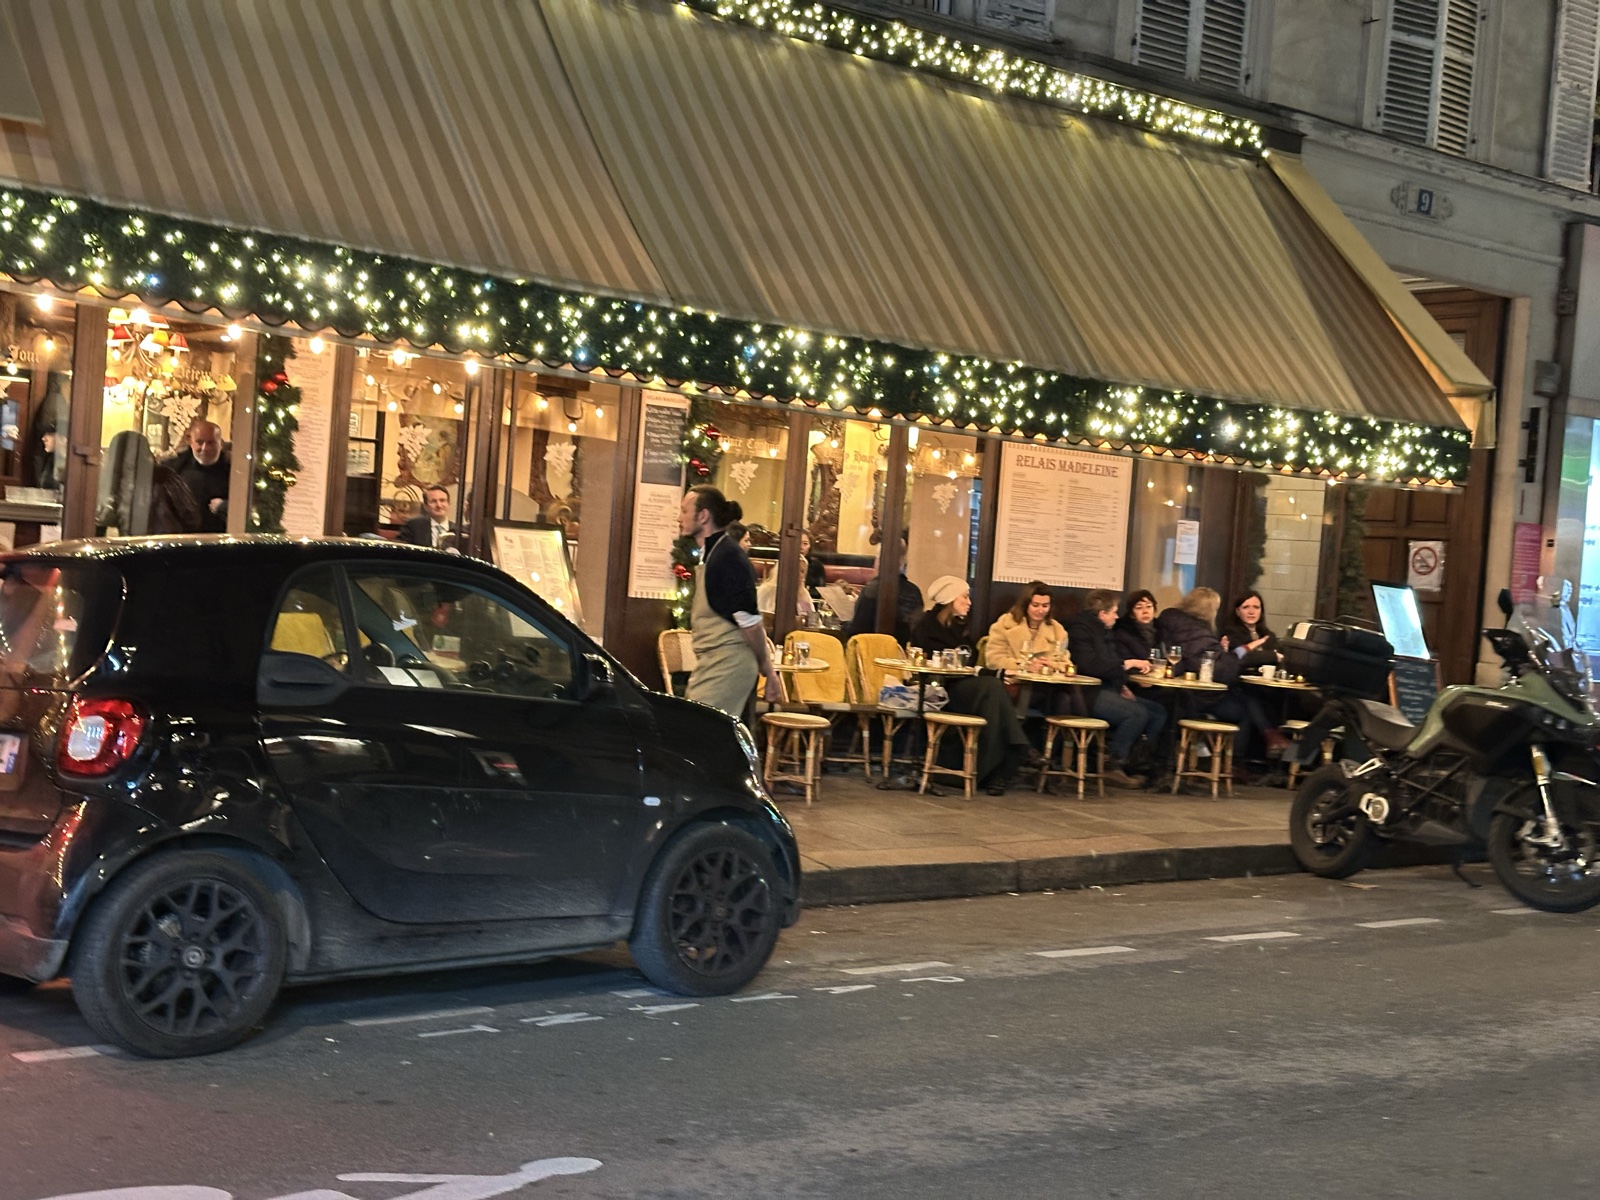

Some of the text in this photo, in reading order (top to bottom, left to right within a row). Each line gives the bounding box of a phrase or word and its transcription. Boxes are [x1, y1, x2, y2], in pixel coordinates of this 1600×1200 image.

[1421, 192, 1430, 211] 9
[1016, 454, 1119, 478] RELAIS MADELEINE
